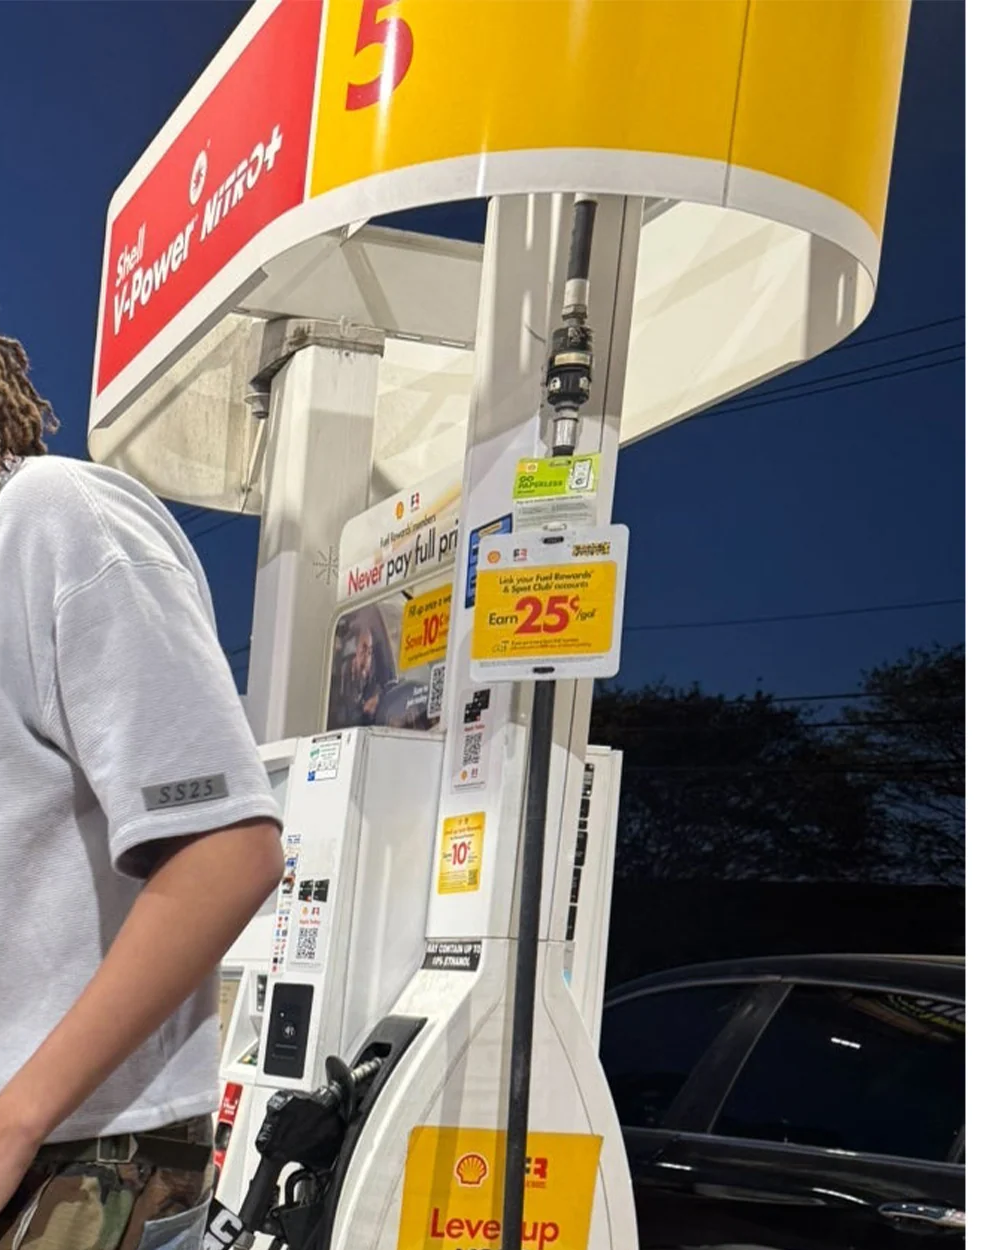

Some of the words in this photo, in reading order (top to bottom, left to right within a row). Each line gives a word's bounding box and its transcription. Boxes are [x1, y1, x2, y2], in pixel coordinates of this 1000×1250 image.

[344, 0, 415, 111] 5
[113, 220, 196, 336] V-Power
[115, 221, 147, 288] Shell
[347, 563, 385, 597] Never
[386, 550, 412, 586] pay
[415, 526, 436, 566] full
[516, 576, 534, 586] your
[535, 573, 553, 582] Fuel
[554, 570, 592, 580] Rewards
[488, 612, 519, 625] Earn
[157, 783, 215, 805] SS25
[430, 1208, 500, 1240] Leve
[521, 1221, 560, 1250] up
